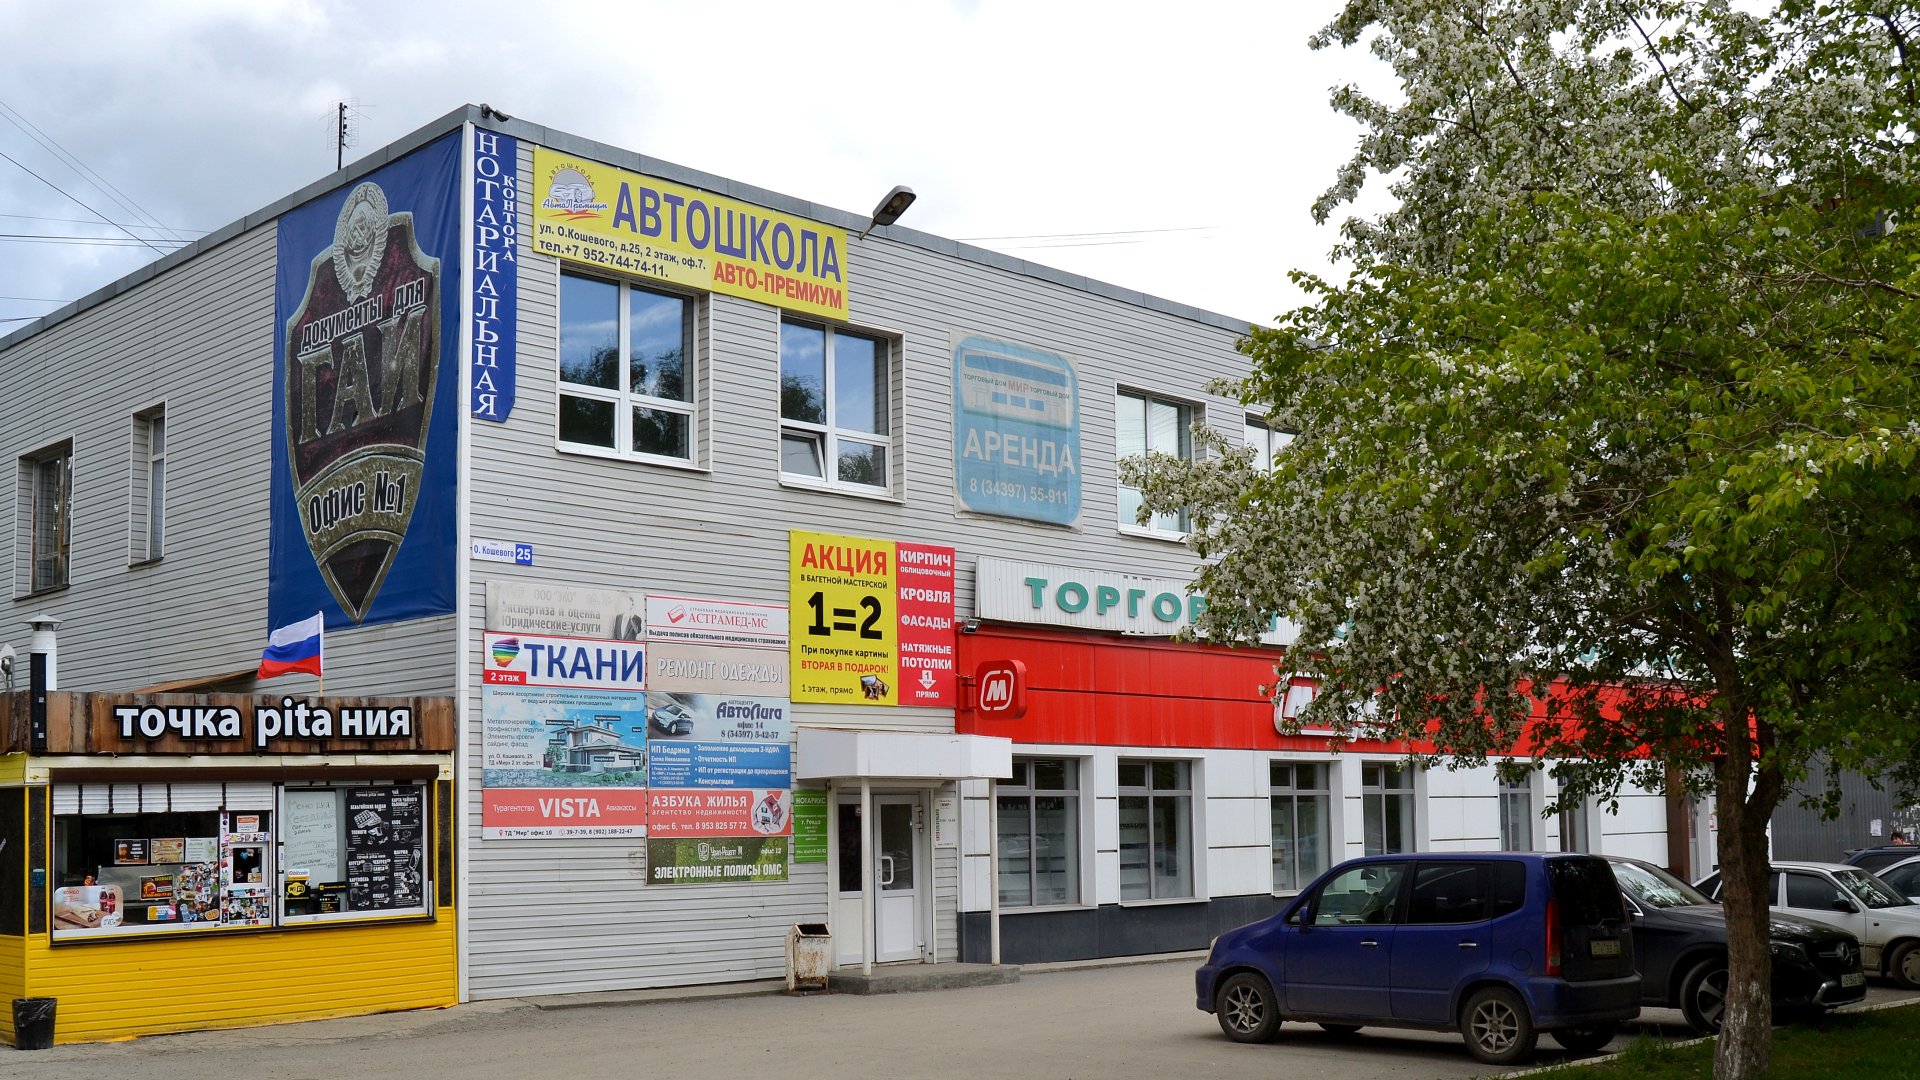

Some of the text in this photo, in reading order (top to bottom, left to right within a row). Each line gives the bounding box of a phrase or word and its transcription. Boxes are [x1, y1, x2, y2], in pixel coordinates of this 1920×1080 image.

[549, 163, 595, 186] АВТОШКОЛА
[543, 198, 608, 212] АвтоПремиум
[503, 175, 515, 262] КОНТОРА
[612, 181, 842, 283] АВТОШКОЛА
[539, 224, 706, 270] ул. О.Кошевого, д.25, 2 этаж, оф.7.
[539, 240, 669, 277] тел.+7 952-744-74-11.
[475, 131, 500, 416] НОТАРИАЛЬНАЯ
[713, 260, 842, 310] АВТО-ПРЕМИУМ
[297, 305, 427, 444] ГАИ
[964, 374, 993, 385] ТОРГОВЫЙ
[994, 379, 1007, 387] ДОМ
[1008, 380, 1029, 393] МИР
[1030, 387, 1058, 398] ТОРГОВЫЙ
[963, 428, 1076, 477] АРЕНДА
[969, 478, 1068, 505] 8 (34397) 55-911
[309, 471, 407, 535] Офис №1
[474, 544, 515, 557] О. Кошевого
[516, 548, 531, 561] 25
[900, 550, 950, 567] КИРПИЧ
[801, 543, 887, 577] АКЦИЯ
[900, 566, 950, 578] ОБЛИЦОВОЧНЫЙ
[806, 574, 842, 585] БАГЕТНОЙ
[843, 578, 888, 589] МАСТЕРСКОЙ
[900, 588, 950, 604] КРОВЛЯ
[570, 622, 601, 633] услуги
[688, 612, 769, 628] АСТРАМЕД-МС
[901, 614, 951, 630] ФАСАДЫ
[801, 645, 889, 659] При покупке картины
[901, 642, 952, 655] НАТЯЖНЫЕ
[523, 643, 643, 683] ТКАНИ
[657, 657, 783, 683] РЕМОНТ ОДЕЖДЫ
[801, 660, 889, 674] ВТОРАЯ В ПОДАРОК!
[901, 657, 952, 669] ПОТОЛКИ
[490, 672, 520, 683] 2 этаж
[924, 672, 930, 680] 1
[802, 684, 853, 695] 1 этаж, прямо
[916, 691, 939, 699] ПРЯМО
[116, 708, 241, 737] точка
[720, 730, 726, 738] 8
[651, 745, 661, 754] ИП
[493, 804, 535, 813] Турагентство
[539, 798, 600, 818] VISTA
[652, 795, 747, 807] АЗБУКА ЖИЛЬЯ
[652, 823, 669, 831] офис
[671, 822, 678, 830] 6,
[695, 822, 700, 830] 8
[701, 822, 714, 830] 953
[715, 822, 728, 830] 825
[729, 822, 737, 830] 57
[739, 822, 747, 830] 72
[654, 863, 782, 879] ЭЛЕКТРОННЫЕ ПОЛИСЫ ОМС
